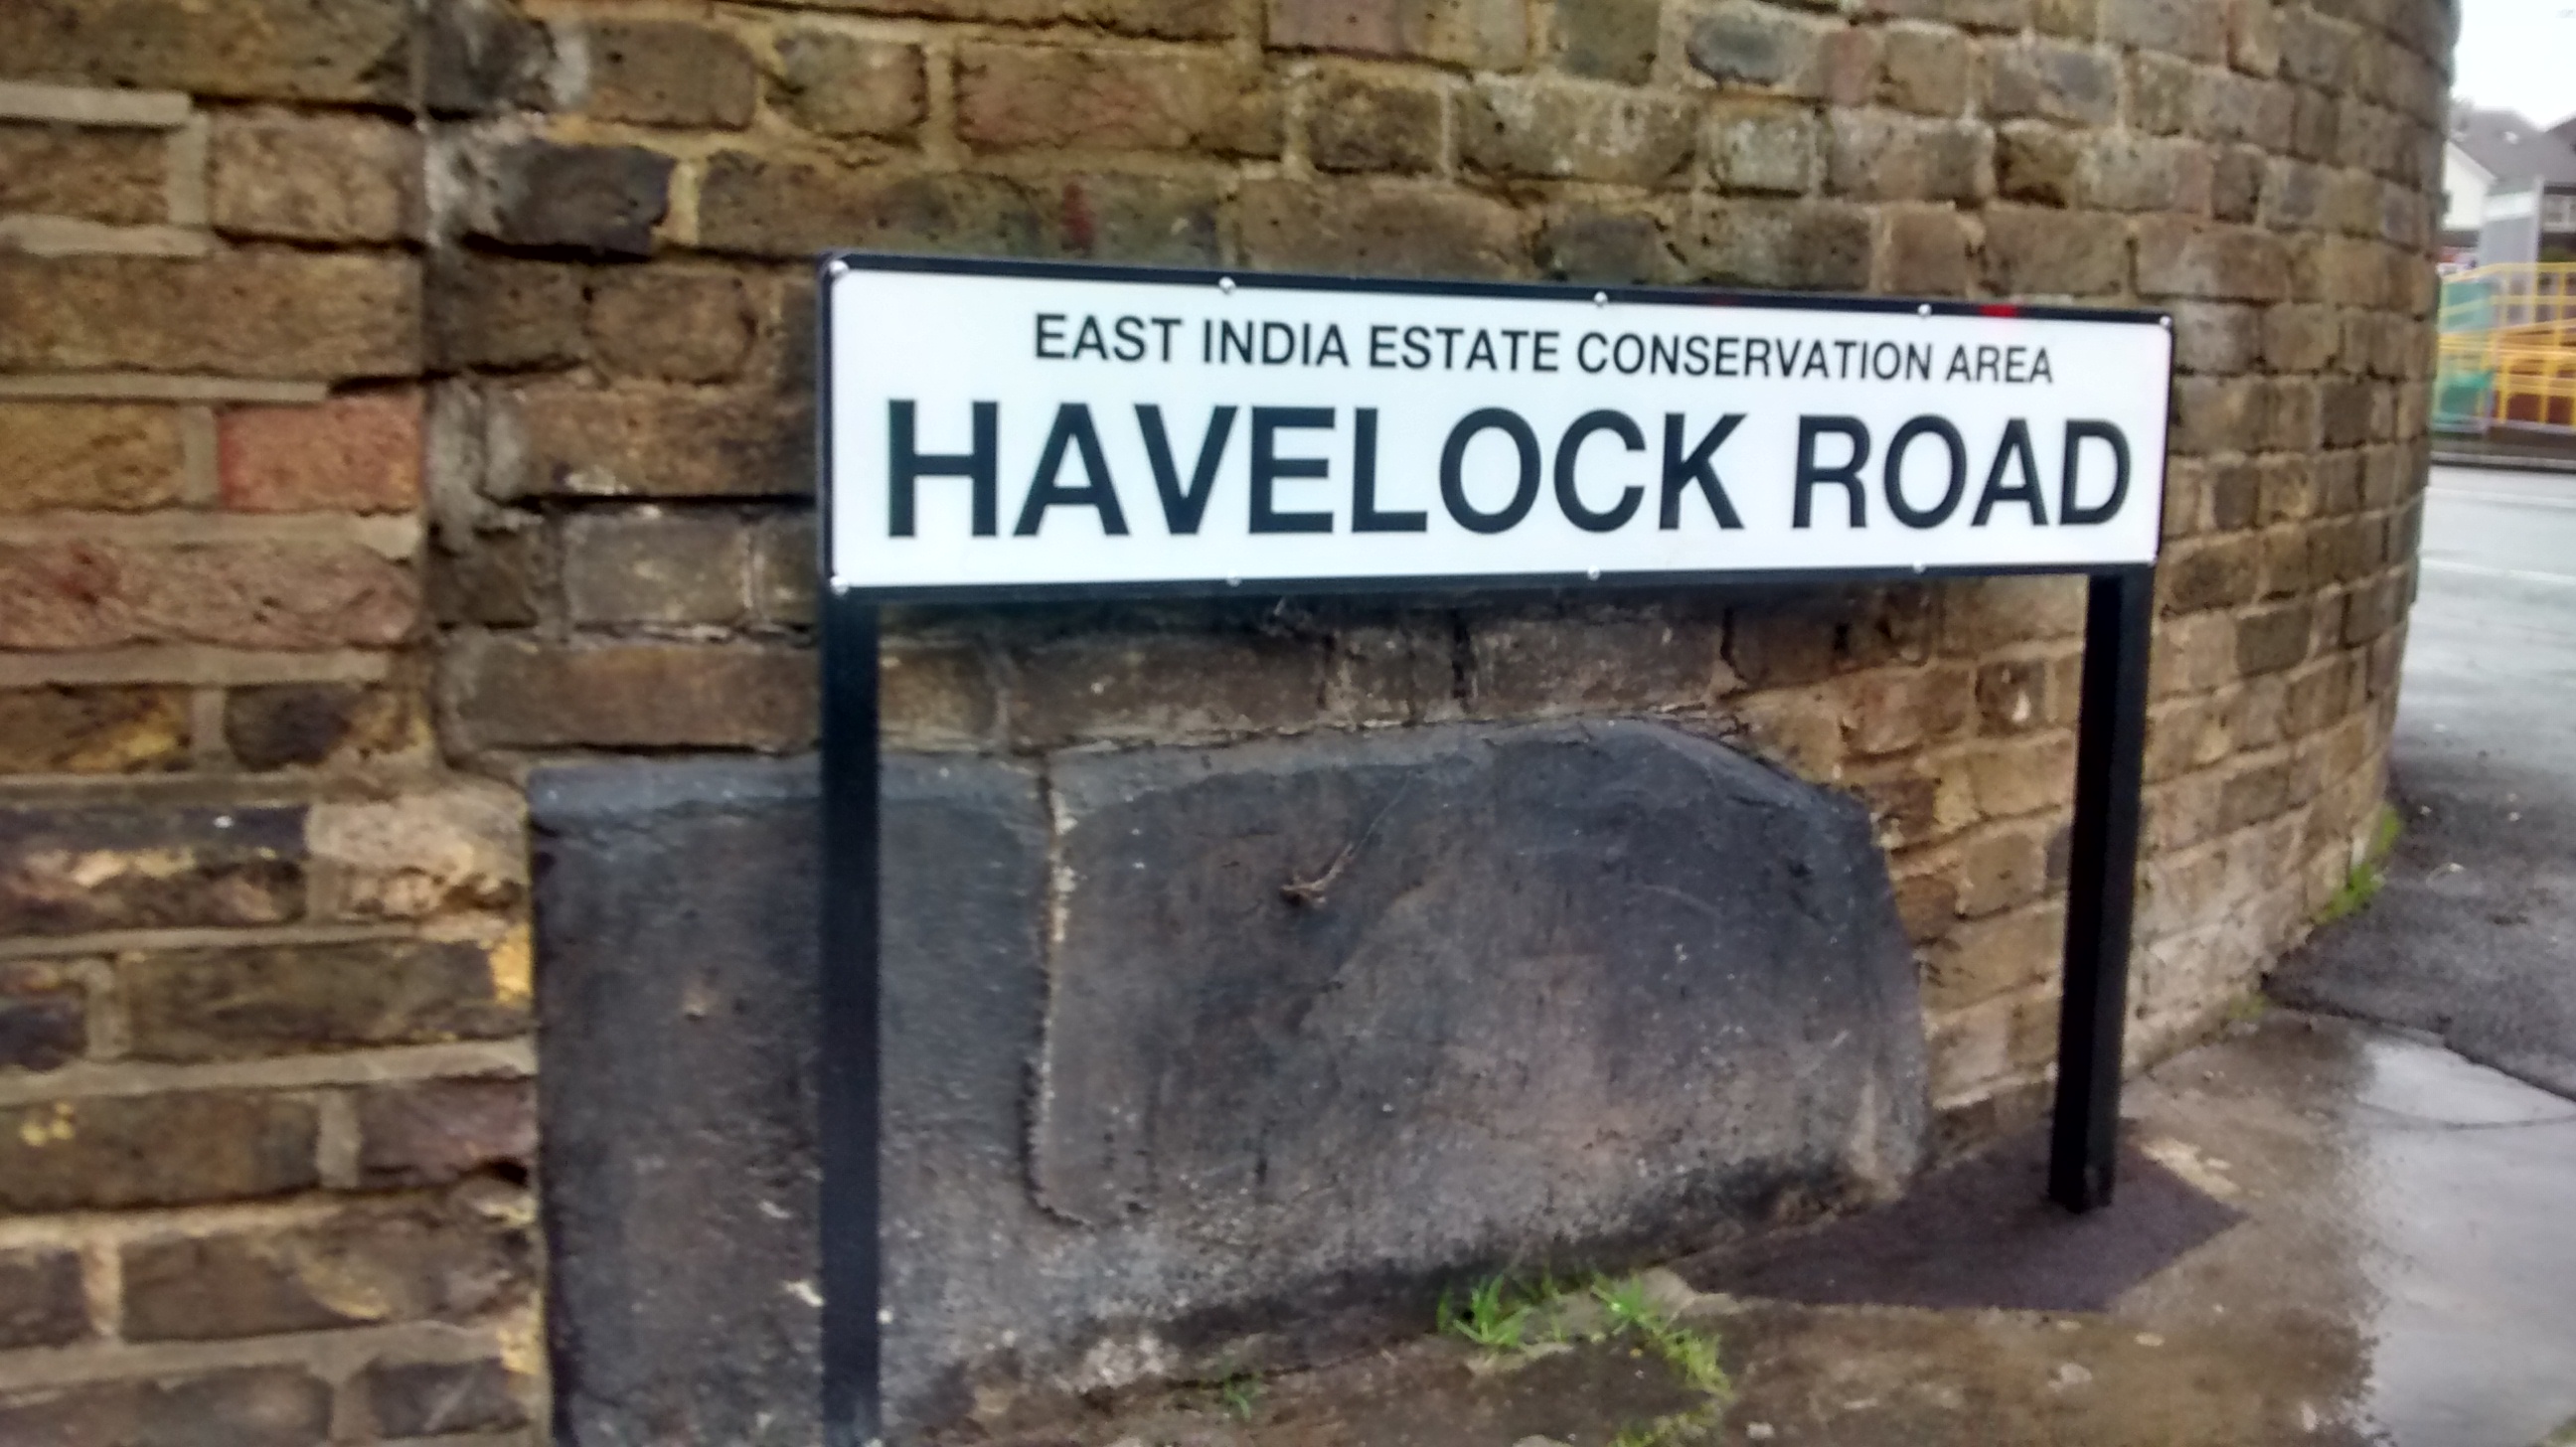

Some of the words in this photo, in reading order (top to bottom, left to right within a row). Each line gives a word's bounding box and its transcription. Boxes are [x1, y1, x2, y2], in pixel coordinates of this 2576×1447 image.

[1035, 312, 1183, 363] EAST
[1203, 318, 1350, 368] INDIA
[1368, 325, 1560, 373] ESTATE
[1576, 331, 1932, 381] CONSERVATION
[1945, 344, 2053, 384] AREA
[887, 399, 1747, 539] HAVELOCK
[1791, 413, 2132, 531] ROAD
